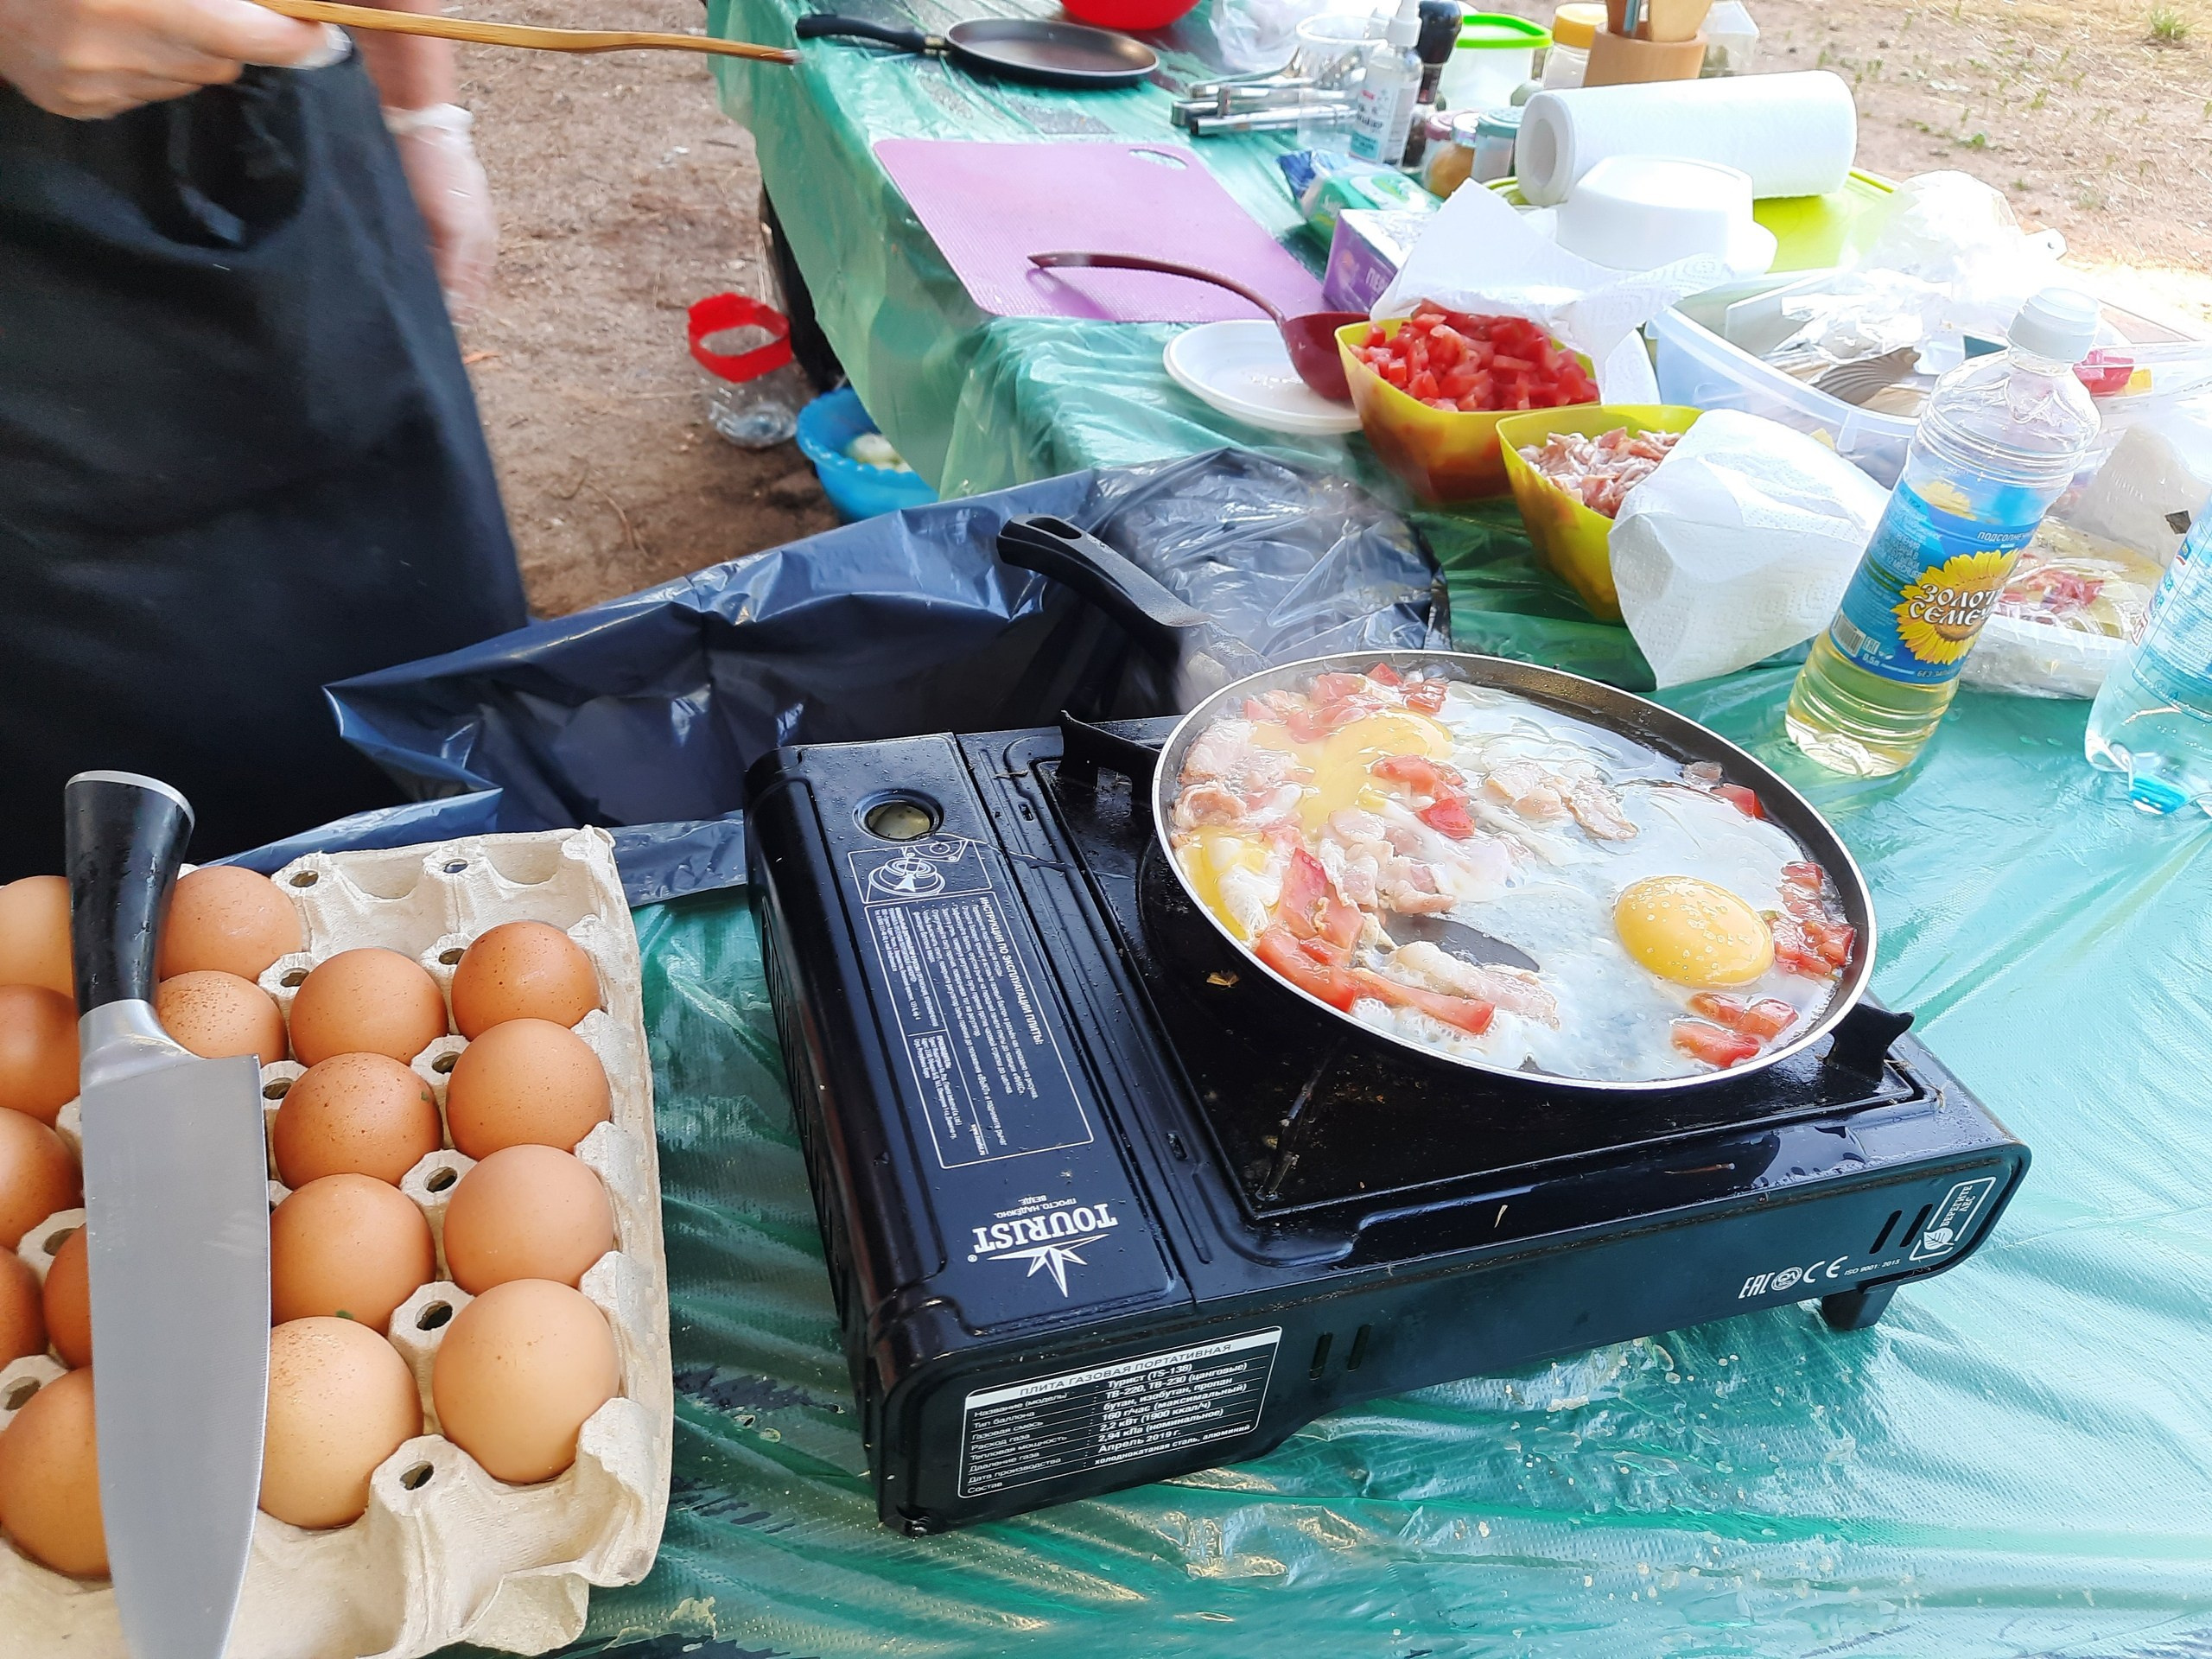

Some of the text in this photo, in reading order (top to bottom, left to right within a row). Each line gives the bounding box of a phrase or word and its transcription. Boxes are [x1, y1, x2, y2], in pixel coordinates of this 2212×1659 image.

[977, 896, 1046, 1045] ИНСТРУКЦИЯ ПО ЭКСПЛУАТАЦИИ ПЛИТЫ:
[994, 1198, 1077, 1219] ПРОСТО. НАДЁЖНО.
[1017, 1195, 1047, 1205] ВЕЗДЕ.
[1940, 1185, 1973, 1227] БЕРЕГИТЕ
[1959, 1196, 1976, 1212] ЛЕС
[971, 1204, 1119, 1253] TOURIST
[1844, 1268, 1859, 1276] ISO
[1881, 1259, 1901, 1268] 2015
[1019, 1341, 1232, 1396] ПЛИТА ГАЗОВАЯ ПОРТАТИВНАЯ
[1106, 1372, 1147, 1390] Турист
[1146, 1362, 1193, 1381] (TS-138)
[1187, 1361, 1248, 1383] (цанговые)
[1101, 1410, 1122, 1421] 160
[1122, 1403, 1151, 1417] г/час
[1153, 1382, 1247, 1411] (максимальный)
[1102, 1396, 1138, 1411] бутан,
[1138, 1384, 1192, 1404] изобутан,
[1192, 1376, 1233, 1392] пропан
[1097, 1430, 1121, 1443] 2,94
[1122, 1425, 1143, 1437] кПа
[1145, 1408, 1224, 1433] (номинальное)
[1098, 1421, 1116, 1433] 2,2
[1117, 1416, 1139, 1427] кВт
[1140, 1408, 1170, 1424] (1900
[1171, 1399, 1212, 1416] ккал/ч)
[967, 1428, 1181, 1484] Дата производства Апрель 2019 г.
[967, 1423, 1250, 1494] Состав холоднокатаная сталь, алюминий
